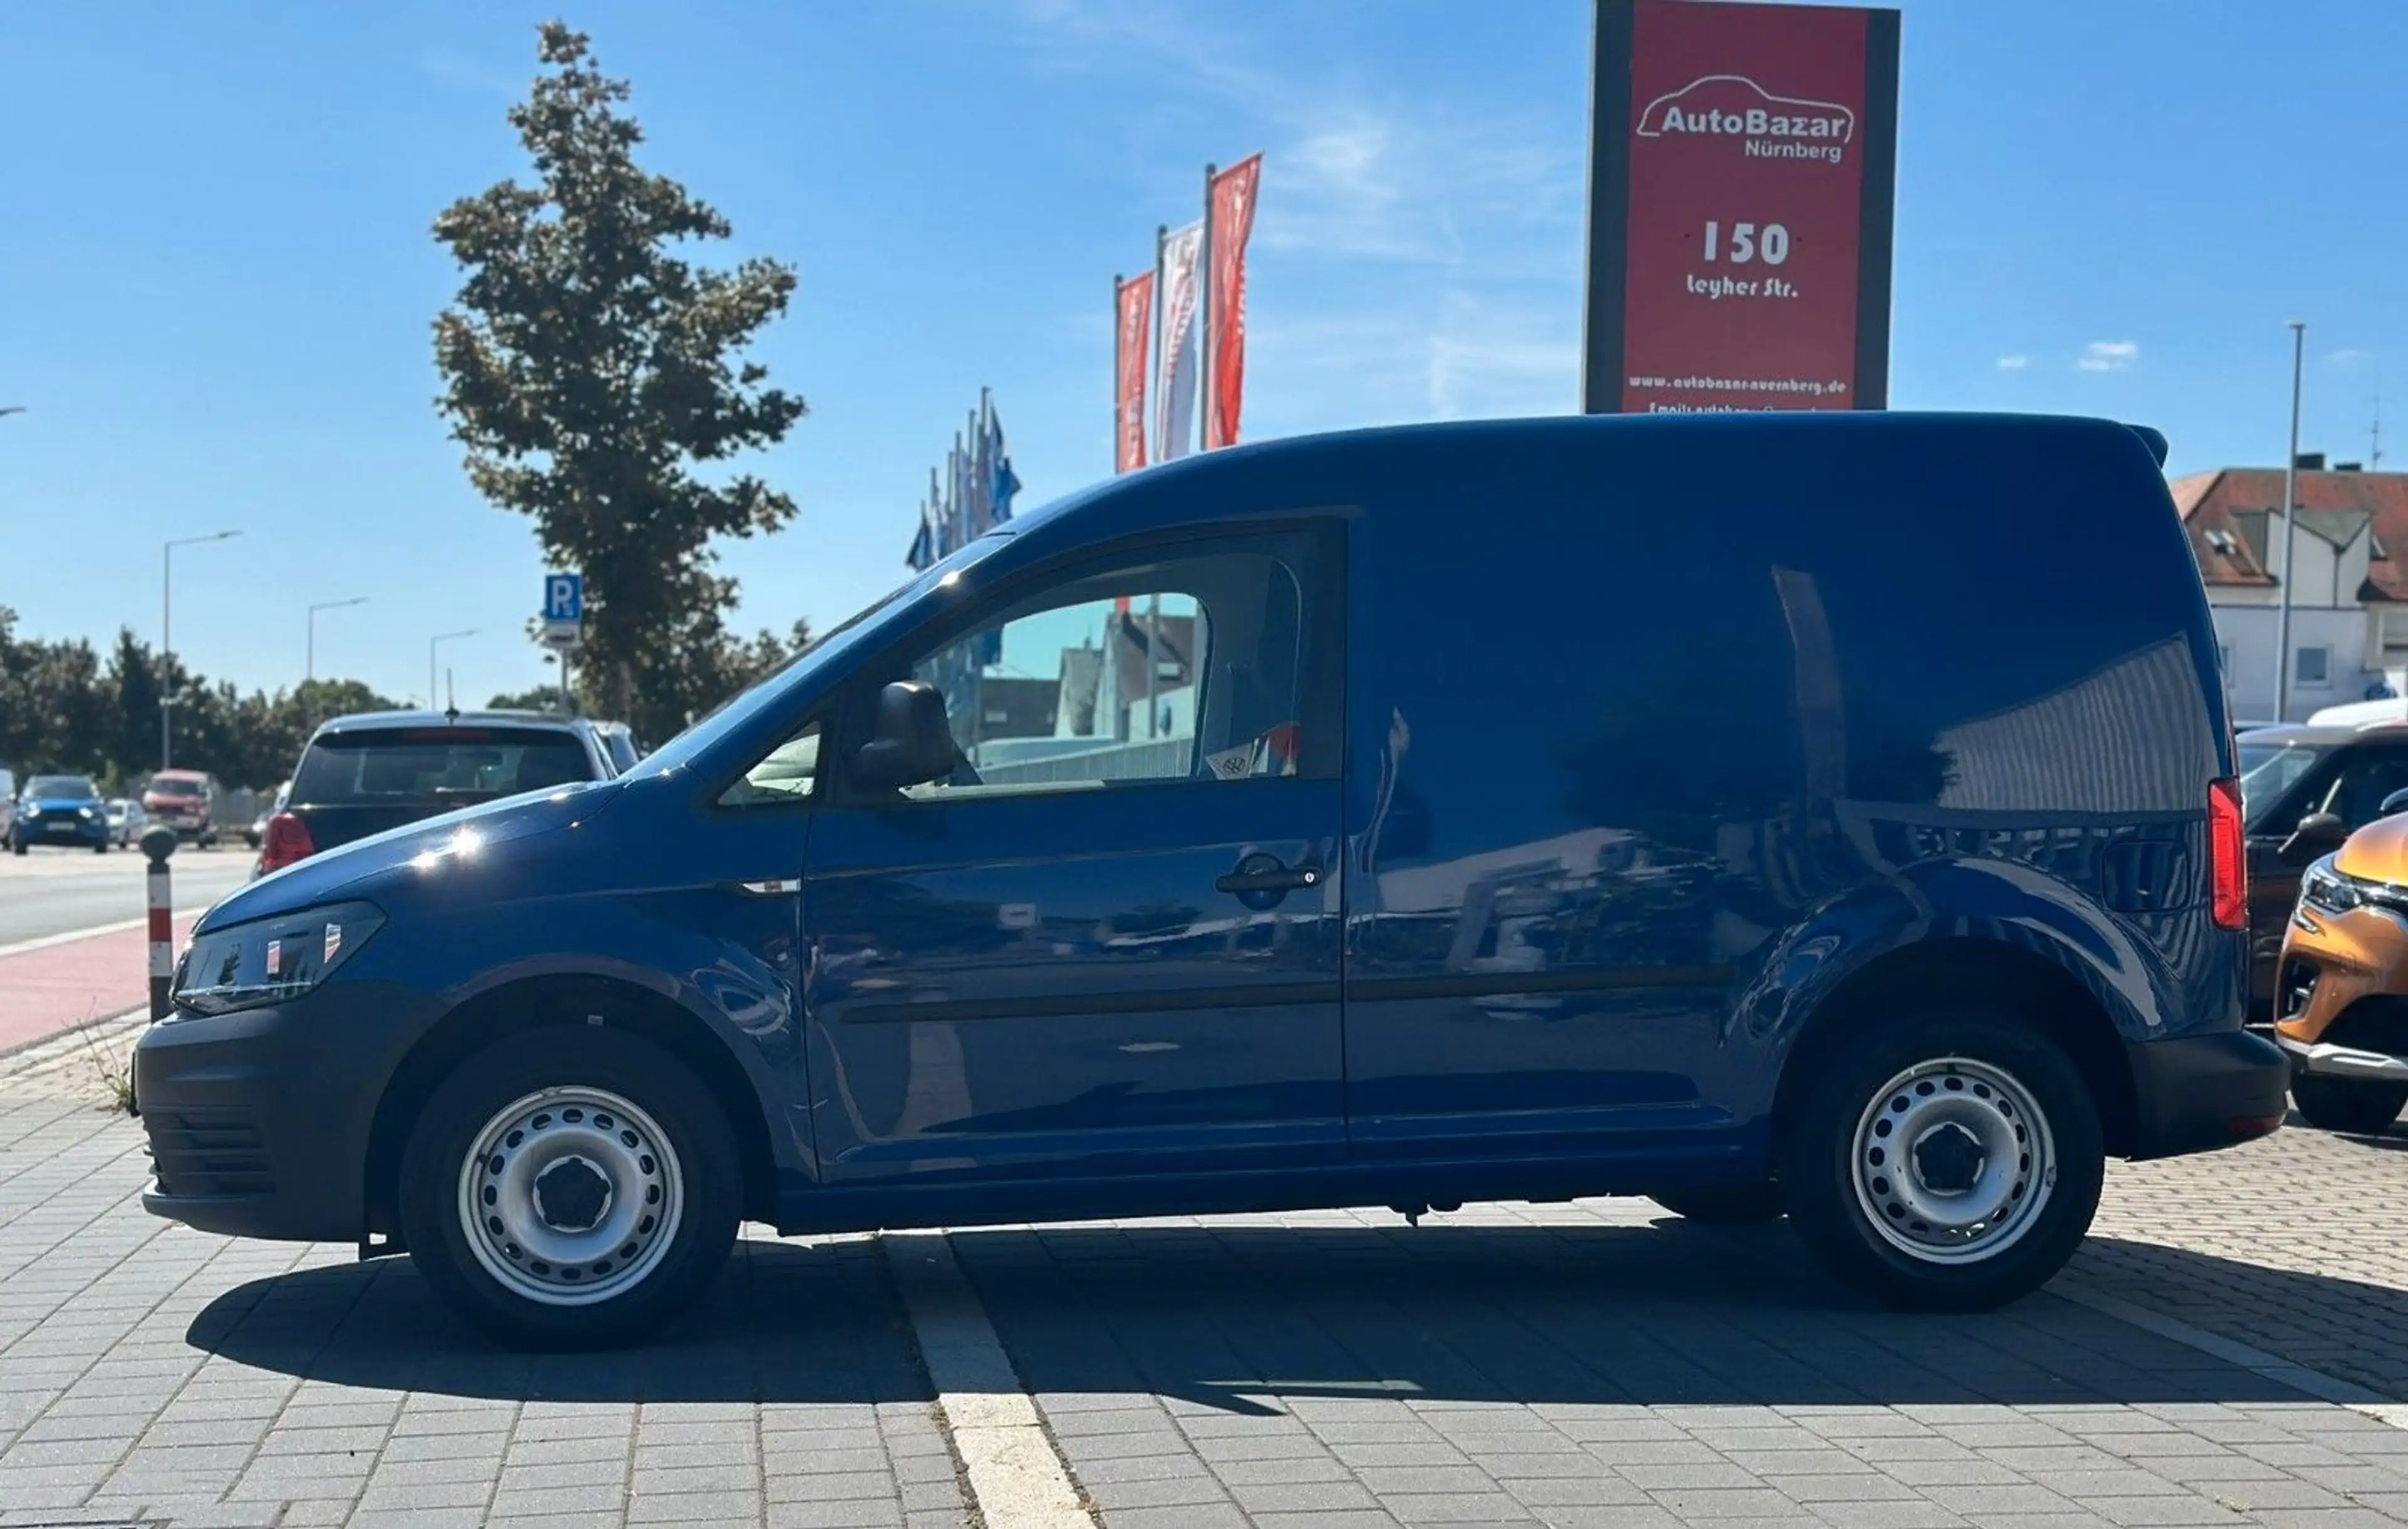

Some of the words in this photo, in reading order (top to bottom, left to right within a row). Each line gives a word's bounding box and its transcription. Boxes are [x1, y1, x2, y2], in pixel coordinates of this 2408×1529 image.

[1662, 107, 1846, 137] AutoBazar
[1745, 140, 1842, 163] Nürnberg
[1704, 221, 1789, 265] 150
[1763, 278, 1799, 297] Str.
